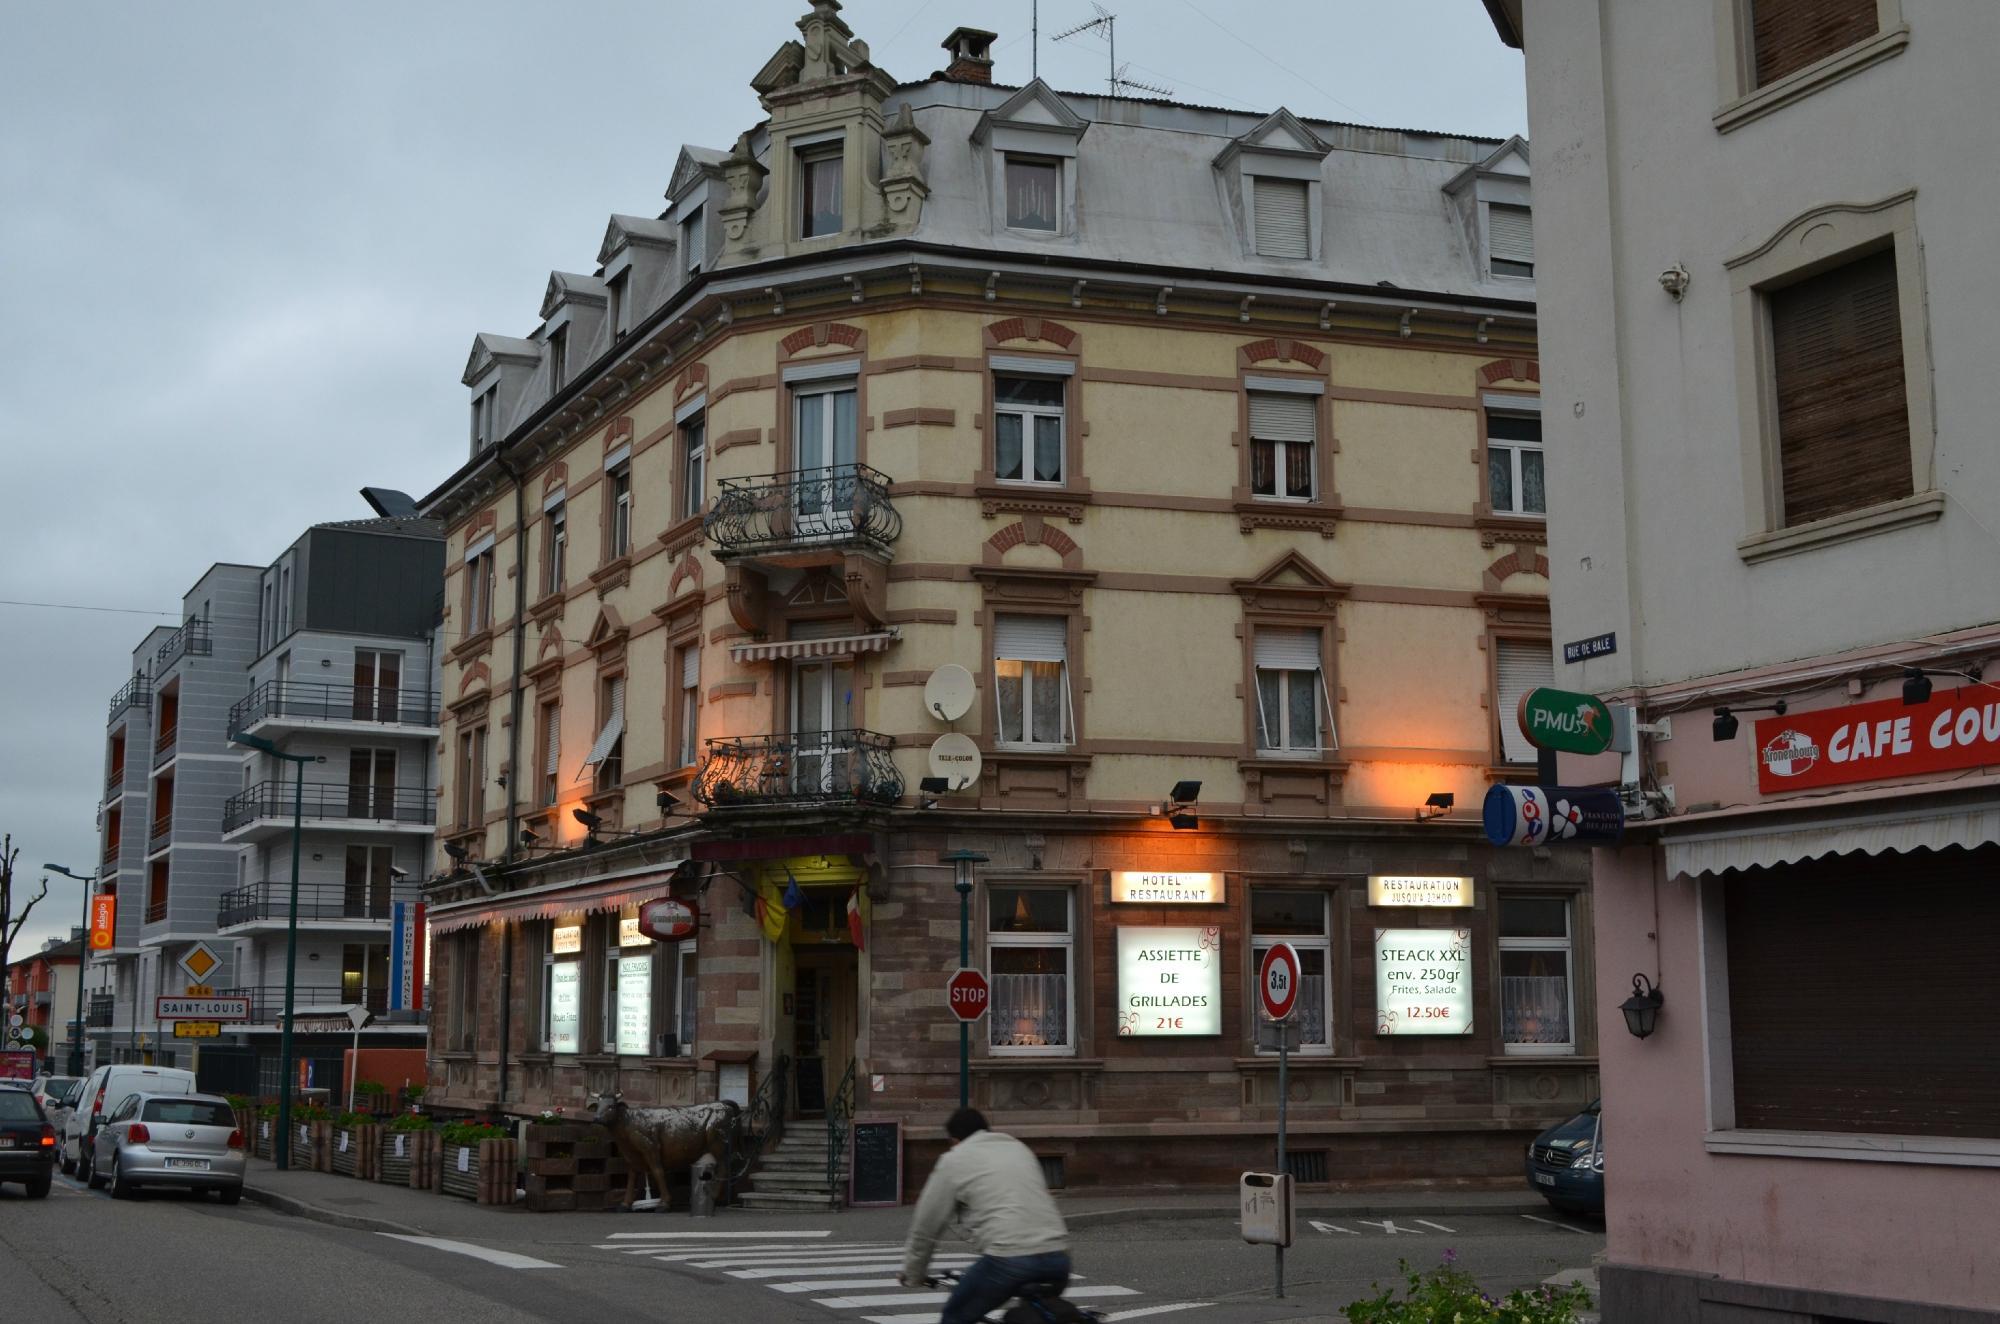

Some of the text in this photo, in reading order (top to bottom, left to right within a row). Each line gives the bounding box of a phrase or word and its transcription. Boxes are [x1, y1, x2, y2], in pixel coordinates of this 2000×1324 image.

[1567, 637, 1610, 659] RUE DE BALE
[1533, 708, 1575, 732] PMU
[1828, 716, 1913, 763] CAFE
[1762, 743, 1820, 765] Kronenbourg
[1142, 875, 1182, 886] HOTEL
[1384, 880, 1459, 891] RESTAURATION
[1130, 889, 1206, 900] RESTAURANT
[97, 903, 108, 930] adagio
[1138, 950, 1201, 961] ASSIETTE
[1382, 950, 1465, 961] STEACK XXL
[1160, 973, 1179, 983] DE
[1271, 970, 1287, 991] 3,5t
[1387, 969, 1460, 983] env. 250gr
[953, 987, 985, 1003] STOP
[1392, 985, 1456, 995] Frites, Salade
[1130, 996, 1207, 1007] GRILLADES
[163, 1003, 243, 1013] SAINT-LOUIS
[1407, 1007, 1450, 1018] 12.50€
[1157, 1018, 1183, 1028] 21€
